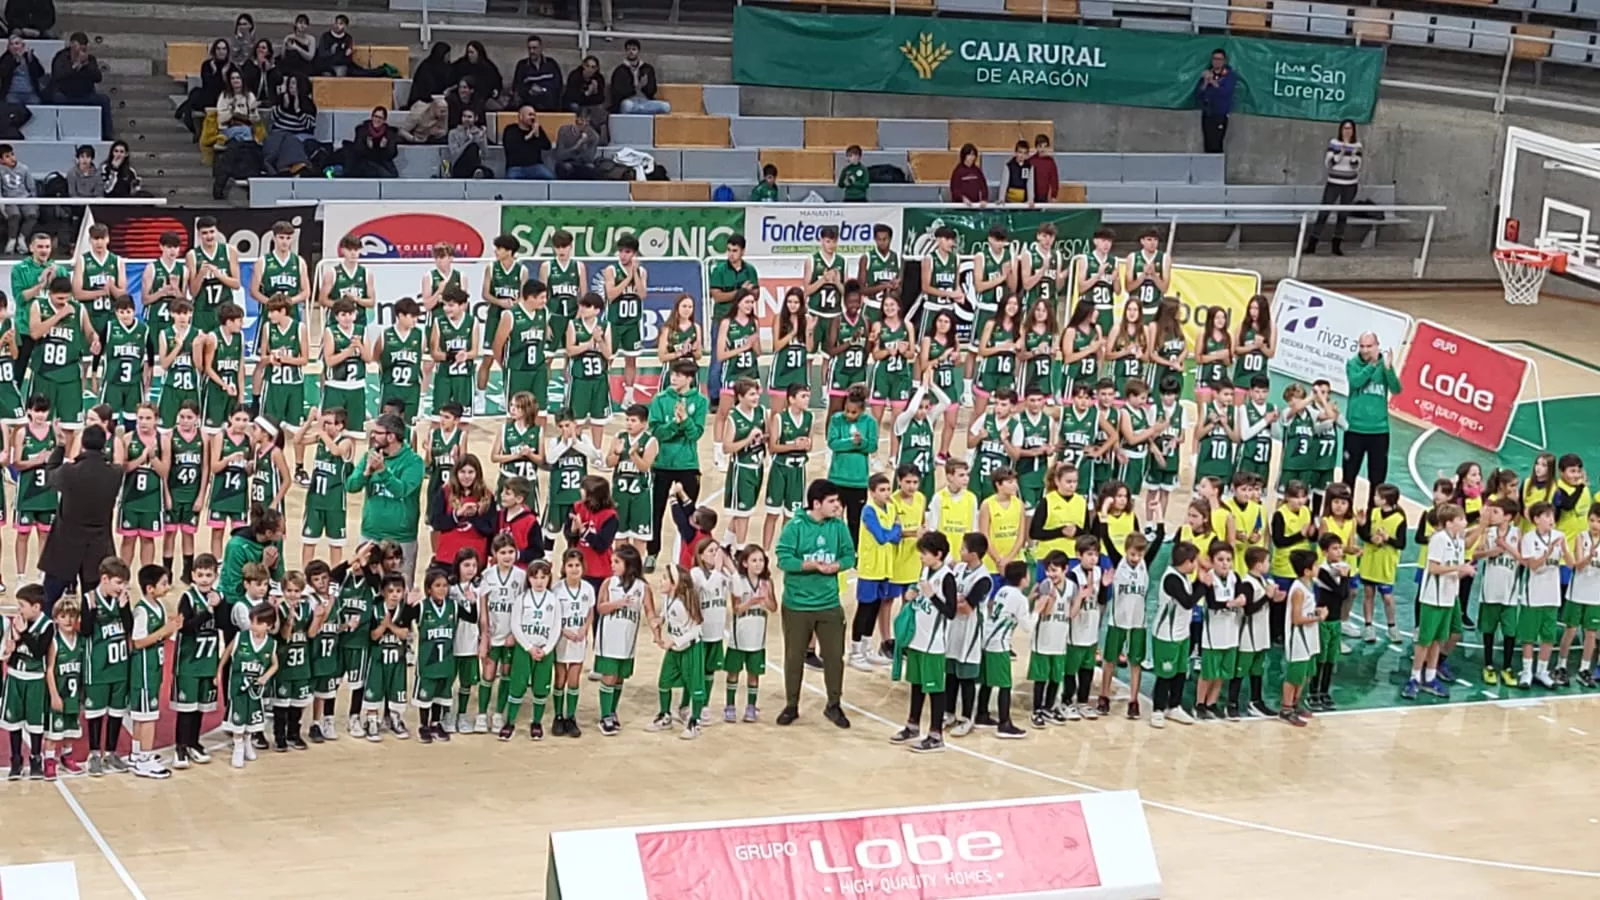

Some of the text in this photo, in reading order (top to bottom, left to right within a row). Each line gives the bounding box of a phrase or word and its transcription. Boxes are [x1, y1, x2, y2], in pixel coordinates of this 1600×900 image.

[960, 40, 1107, 68] CAJA RURAL
[976, 67, 1089, 88] DE ARAGÓN
[1310, 64, 1346, 84] San
[1274, 80, 1345, 102] Lorenzo
[762, 216, 871, 242] Fontecbra
[206, 285, 223, 304] 17
[820, 290, 836, 308] 14
[1041, 282, 1050, 299] 3
[1093, 287, 1110, 303] 20
[561, 301, 568, 316] 1
[619, 300, 638, 317] 00
[1317, 326, 1349, 350] rivas
[44, 344, 67, 365] 88
[527, 345, 536, 365] 8
[737, 351, 752, 368] 33
[787, 350, 802, 367] 31
[845, 351, 863, 367] 28
[1244, 354, 1262, 371] 00
[121, 362, 132, 383] 3
[347, 364, 357, 381] 2
[583, 357, 601, 376] 33
[997, 356, 1011, 373] 16
[1036, 360, 1049, 375] 15
[1081, 358, 1094, 374] 13
[1125, 360, 1139, 376] 12
[1213, 365, 1221, 380] 5
[271, 366, 293, 384] 20
[392, 367, 411, 384] 99
[939, 370, 951, 386] 18
[1420, 364, 1495, 412] Lobe
[1212, 441, 1227, 459] 10
[1254, 444, 1268, 462] 31
[1300, 439, 1307, 454] 3
[1319, 440, 1335, 457] 77
[1064, 449, 1085, 468] 27
[35, 470, 45, 486] 3
[177, 469, 197, 484] 49
[515, 462, 536, 480] 76
[561, 471, 580, 488] 32
[137, 474, 147, 491] 8
[225, 472, 241, 490] 14
[316, 476, 327, 495] 11
[522, 624, 550, 639] PEÑAS
[108, 641, 128, 663] 00
[196, 637, 217, 658] 77
[437, 644, 443, 662] 1
[288, 648, 305, 666] 33
[68, 679, 78, 697] 9
[735, 840, 798, 860] GRUPO
[809, 823, 1004, 873] Lobe
[840, 870, 993, 895] HIGH QUALITY HOMES
